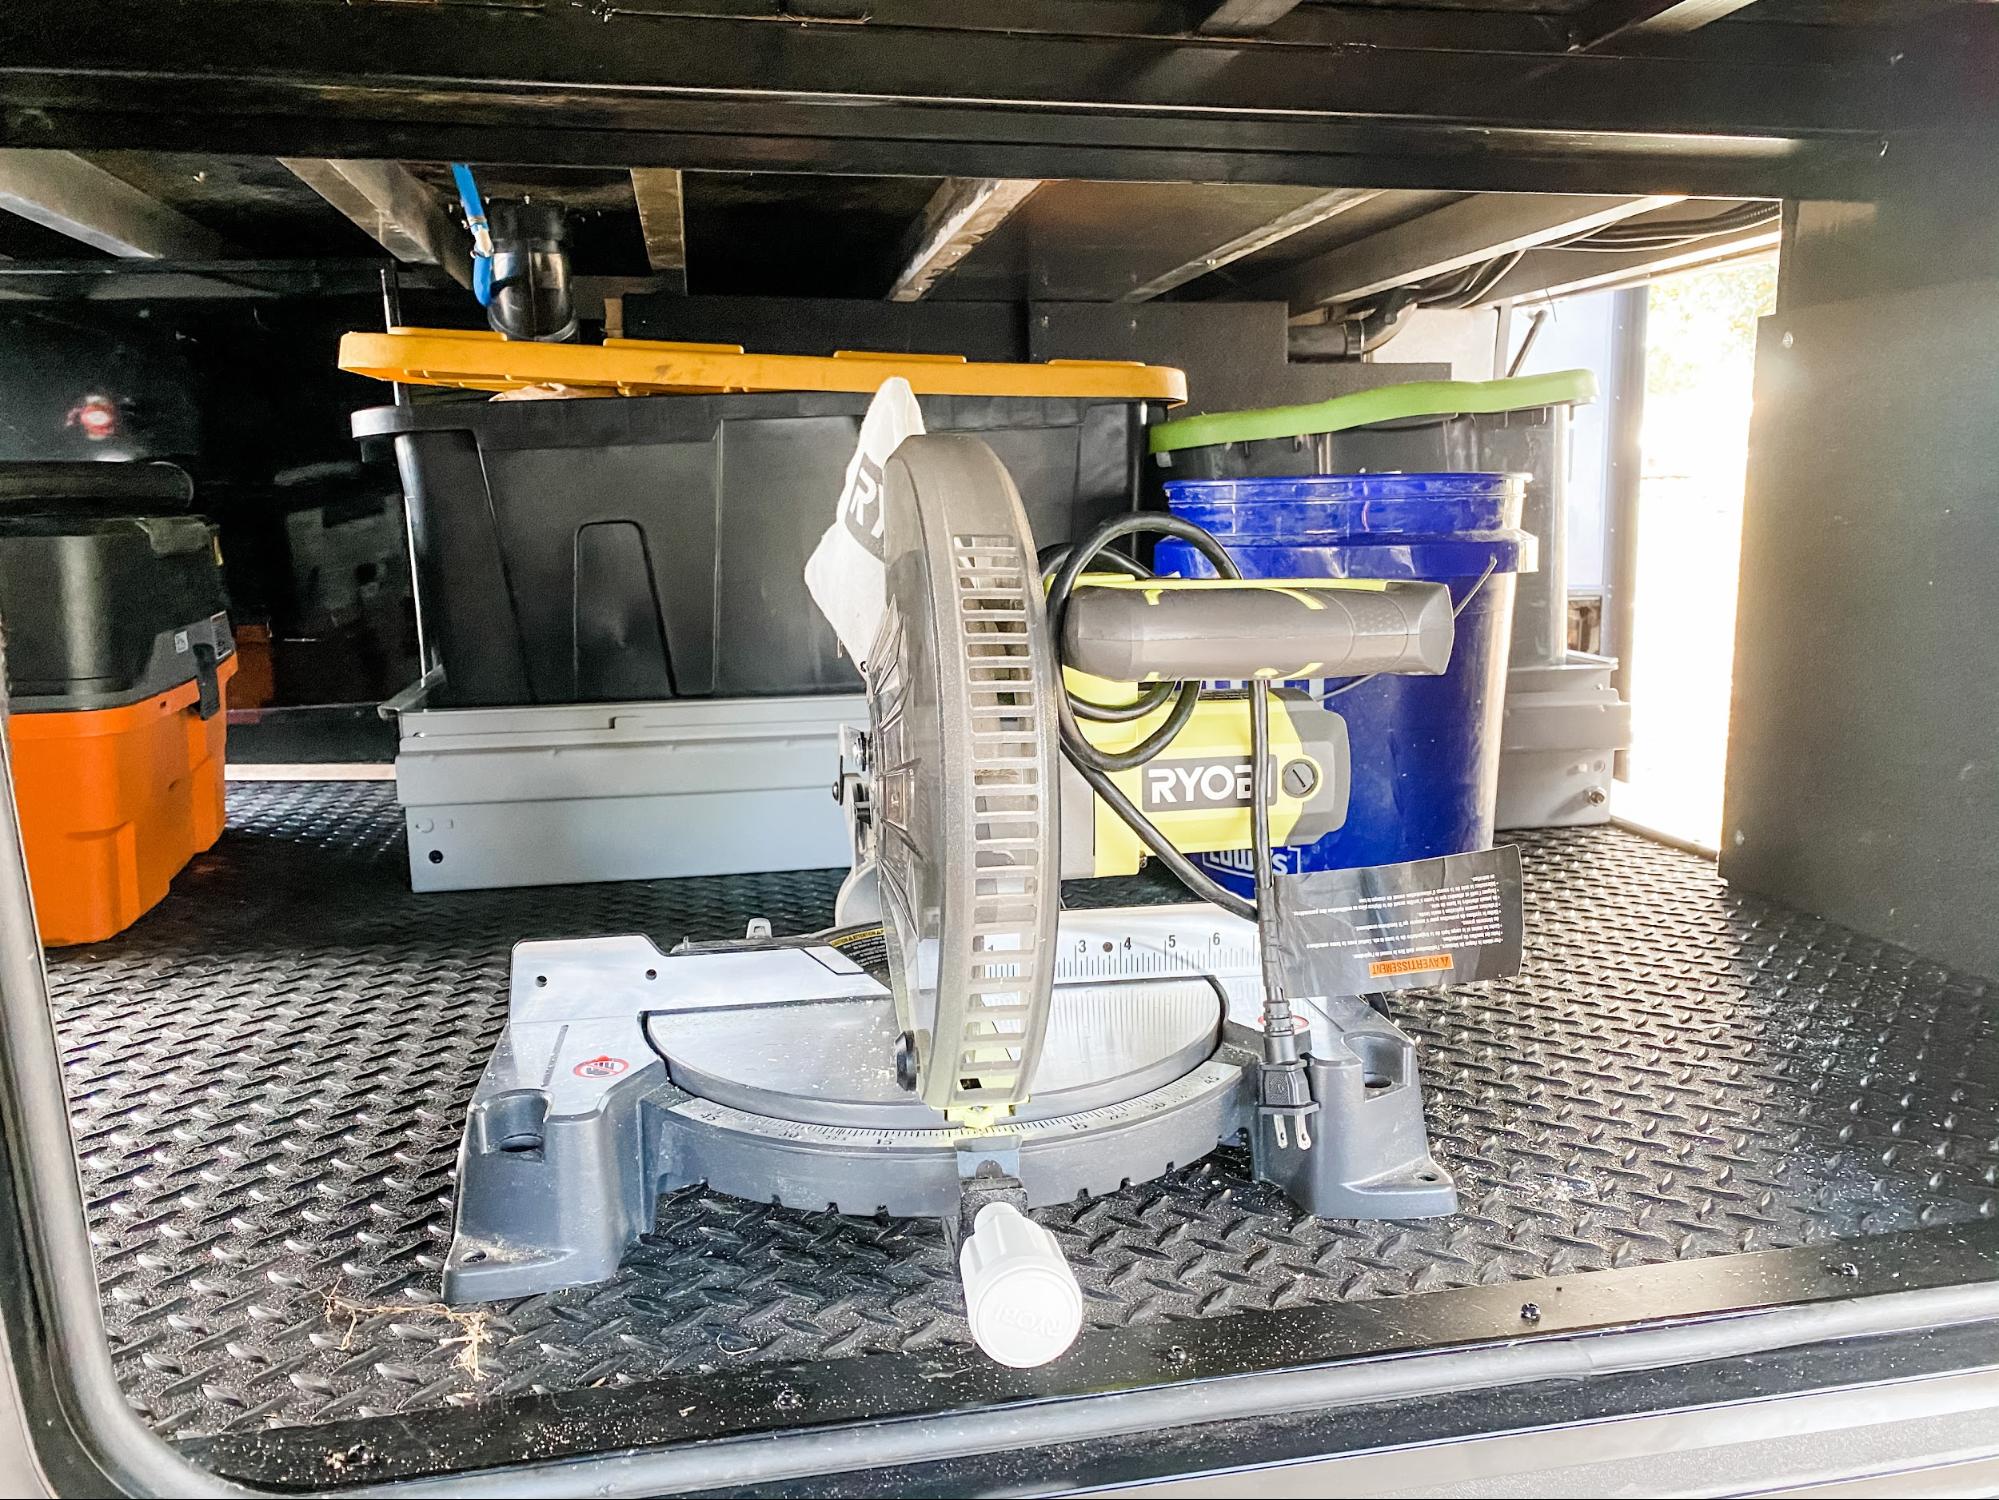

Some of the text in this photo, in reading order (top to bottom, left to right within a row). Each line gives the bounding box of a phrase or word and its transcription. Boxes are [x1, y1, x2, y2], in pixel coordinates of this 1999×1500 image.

[1078, 939, 1087, 953] 3
[1124, 936, 1132, 951] 4
[1168, 934, 1177, 949] 5
[1213, 932, 1221, 947] 6
[1371, 956, 1440, 977] AVERTISSEMENT
